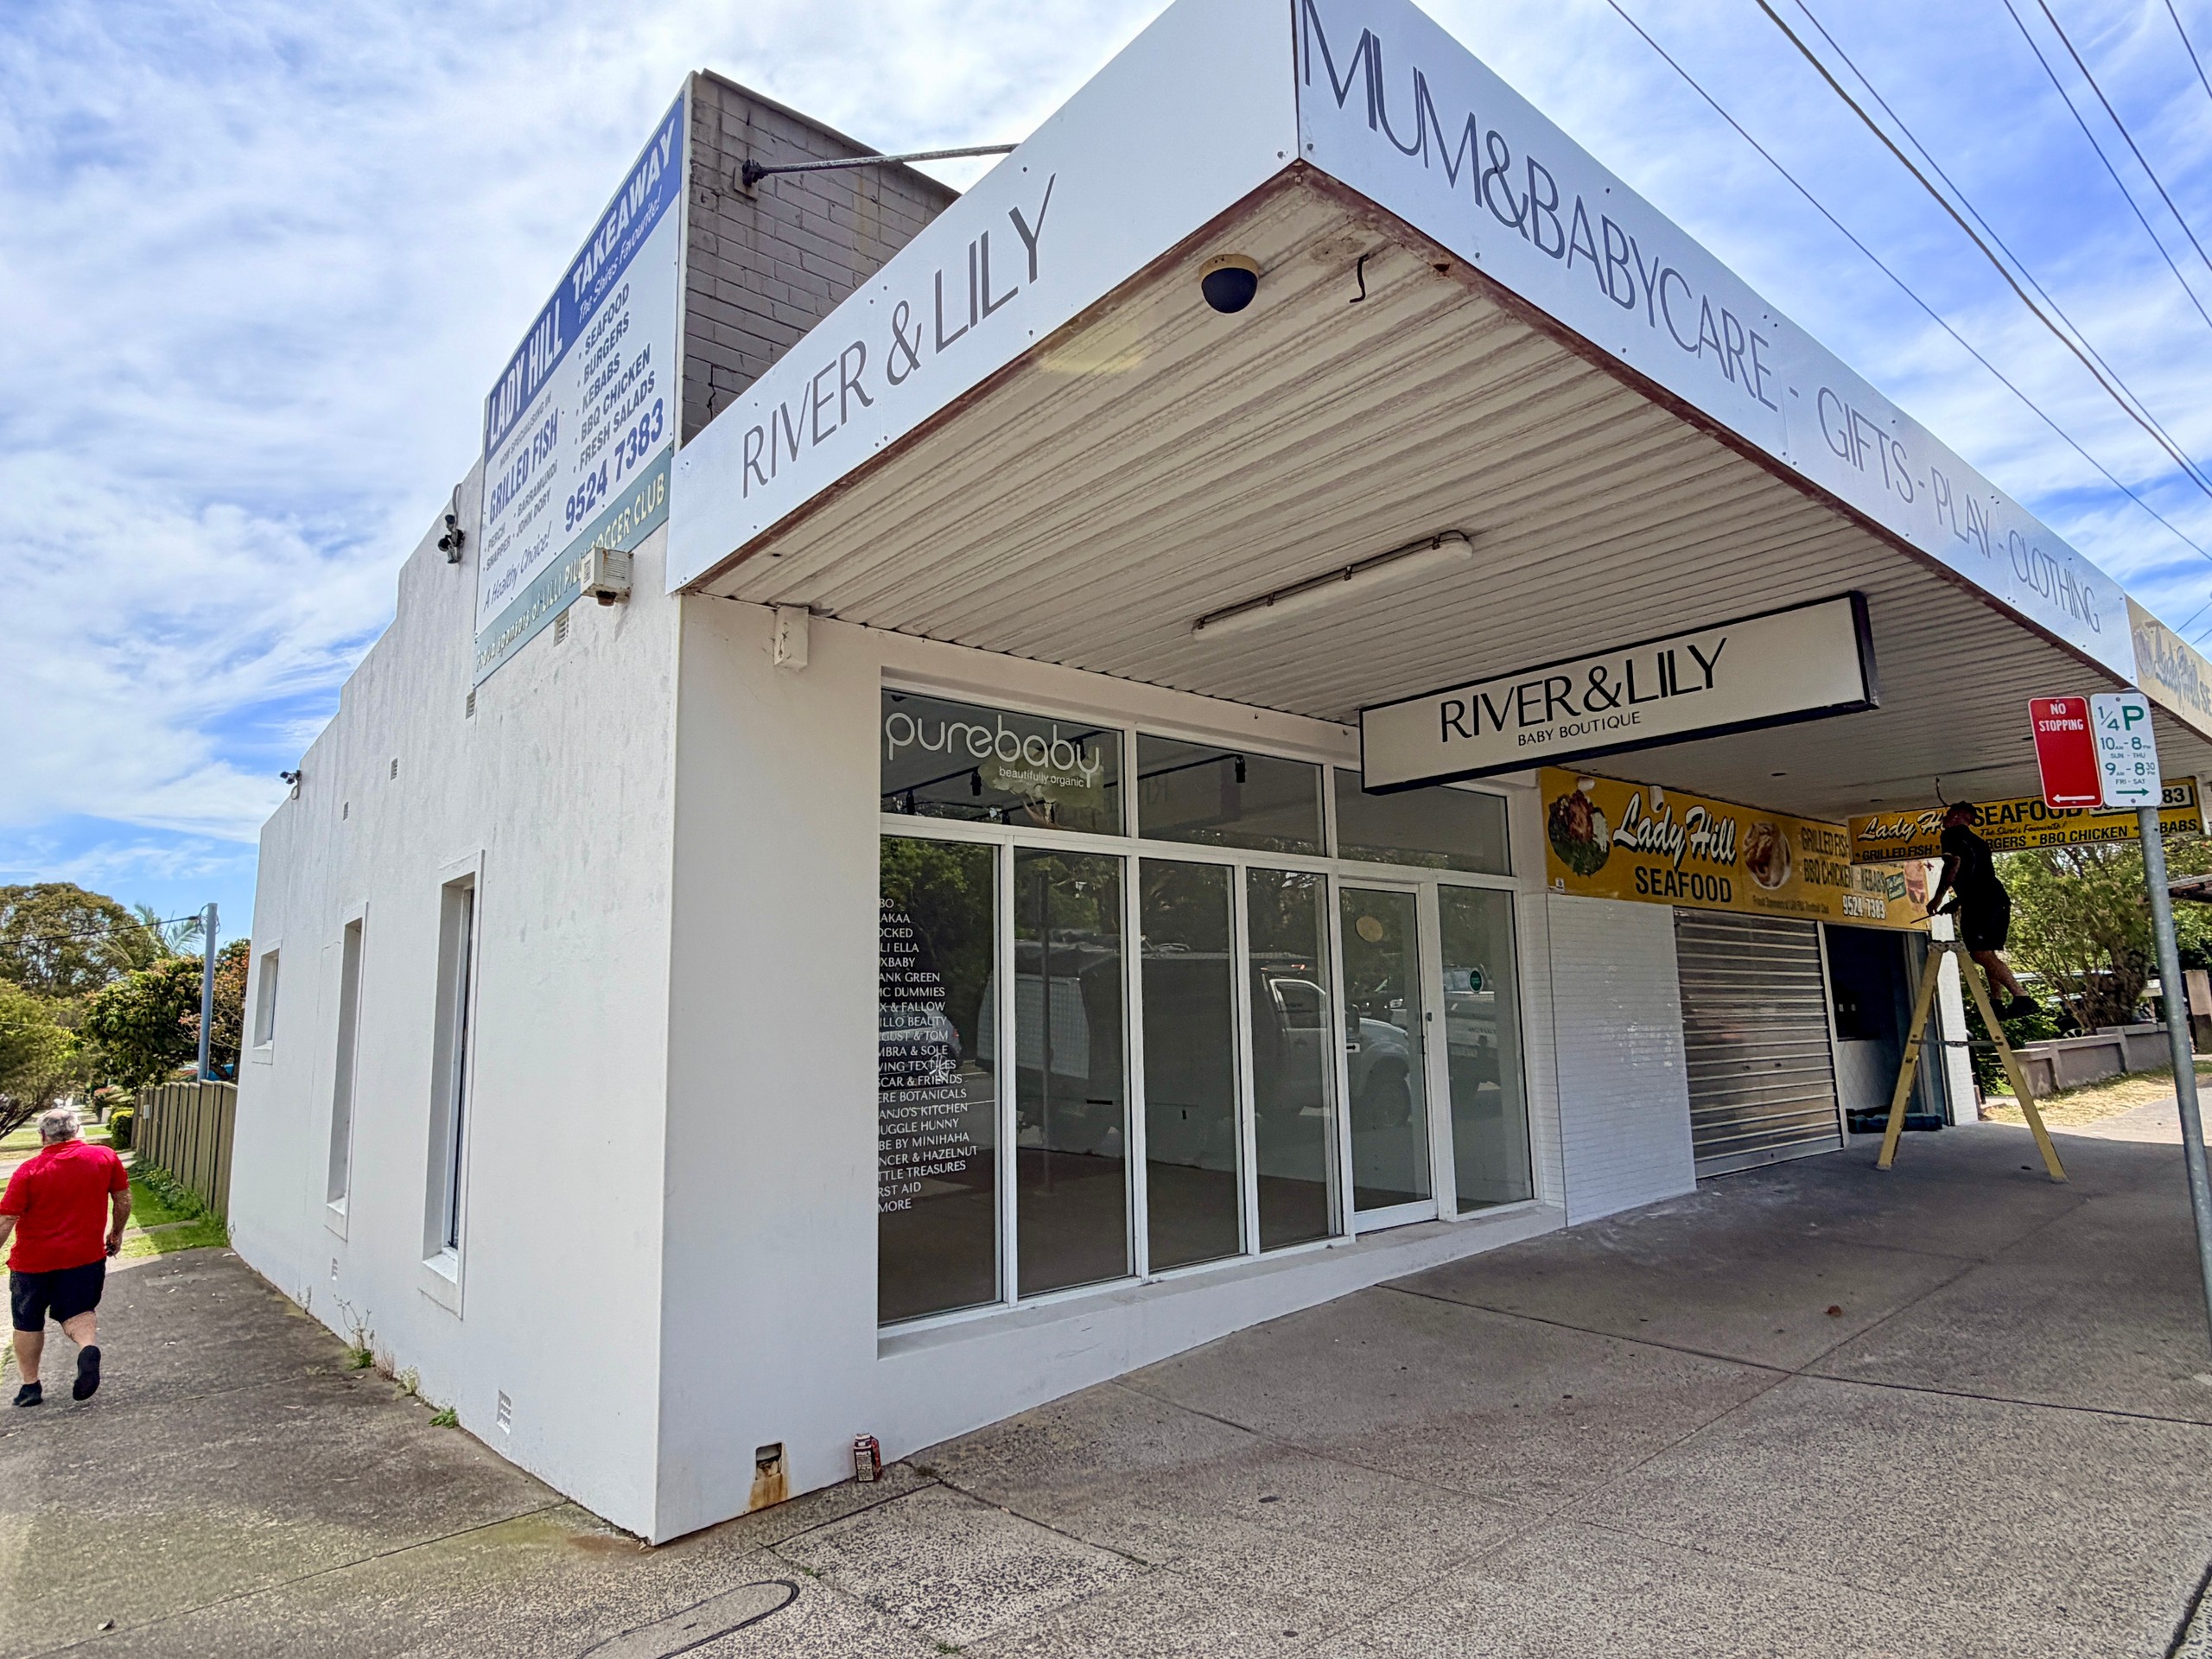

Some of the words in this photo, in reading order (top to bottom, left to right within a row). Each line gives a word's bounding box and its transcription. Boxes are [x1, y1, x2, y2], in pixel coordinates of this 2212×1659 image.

[573, 118, 676, 302] TAKEAWAY
[579, 296, 593, 324] The
[584, 283, 630, 355] SEAFOOD
[583, 311, 630, 385] BURGERS
[742, 340, 874, 499] RIVER
[887, 300, 922, 385] &
[935, 172, 1057, 354] LILY
[489, 350, 525, 451] LADY
[527, 297, 563, 397] HILL
[582, 352, 620, 414] KEBABS
[581, 405, 601, 443] BBQ
[602, 342, 651, 416] CHICKEN
[579, 424, 611, 472] FRESH
[613, 370, 655, 434] SALADS
[490, 447, 530, 525] GRILLED
[531, 406, 559, 474] FISH
[565, 458, 608, 532] 9524
[614, 397, 664, 483] 7383
[518, 459, 557, 518] BARRAMUNDI
[516, 508, 533, 538] JOHN
[533, 486, 552, 518] DORY
[1817, 387, 1914, 504] GIFTS
[1930, 466, 1991, 559] PLAY
[2008, 530, 2101, 635] CLOTHING
[487, 521, 506, 552] PERCH
[486, 534, 512, 571] SNAPPER
[498, 609, 531, 658] sponsors
[633, 472, 665, 526] CLUB
[483, 588, 491, 613] A
[491, 563, 520, 606] Healthy
[2050, 703, 2067, 715] NO
[2121, 705, 2145, 731] P
[1517, 728, 1554, 747] BABY
[1560, 711, 1642, 739] BOUTIQUE
[2038, 719, 2084, 732] STOPPING
[885, 712, 1100, 788] purebaby
[999, 766, 1049, 785] beautifully
[1051, 774, 1084, 789] organic
[1612, 791, 1687, 873] Lady
[1686, 805, 1737, 867] Hill
[1802, 827, 1833, 855] GRILLED
[1857, 816, 1916, 844] Lady
[1862, 847, 1906, 861] GRILLED
[1907, 844, 1933, 857] FISH
[1986, 836, 2026, 849] RGERS
[2040, 831, 2066, 845] BBQ
[2069, 825, 2128, 842] CHICKEN
[2159, 819, 2197, 834] BABS
[1635, 866, 1732, 903] SEAFOOD
[1821, 860, 1853, 889] CHICKEN
[880, 912, 911, 923] AKAA
[1842, 894, 1864, 917] 9524
[893, 943, 919, 952] ELLA
[905, 972, 940, 982] GREEN
[894, 987, 945, 997] DUMMIES
[891, 1001, 898, 1013] &
[901, 1001, 945, 1013] FALLOW
[908, 1016, 947, 1027] BEAUTY
[913, 1030, 921, 1040] &
[925, 1030, 948, 1040] TOM
[910, 1046, 918, 1056] &
[921, 1045, 948, 1055] SOLE
[908, 1059, 957, 1071] TEXTILES
[907, 1076, 915, 1086] &
[918, 1074, 963, 1086] FRIENDS
[899, 1088, 967, 1103] BOTANICALS
[921, 1103, 968, 1116] KITCHEN
[921, 1118, 959, 1131] HUNNY
[895, 1138, 909, 1149] BY
[912, 1132, 969, 1147] MINIHAHA
[912, 1152, 920, 1163] &
[923, 1146, 978, 1161] HAZELNUT
[906, 1160, 966, 1178] TREASURES
[901, 1181, 921, 1194] AID
